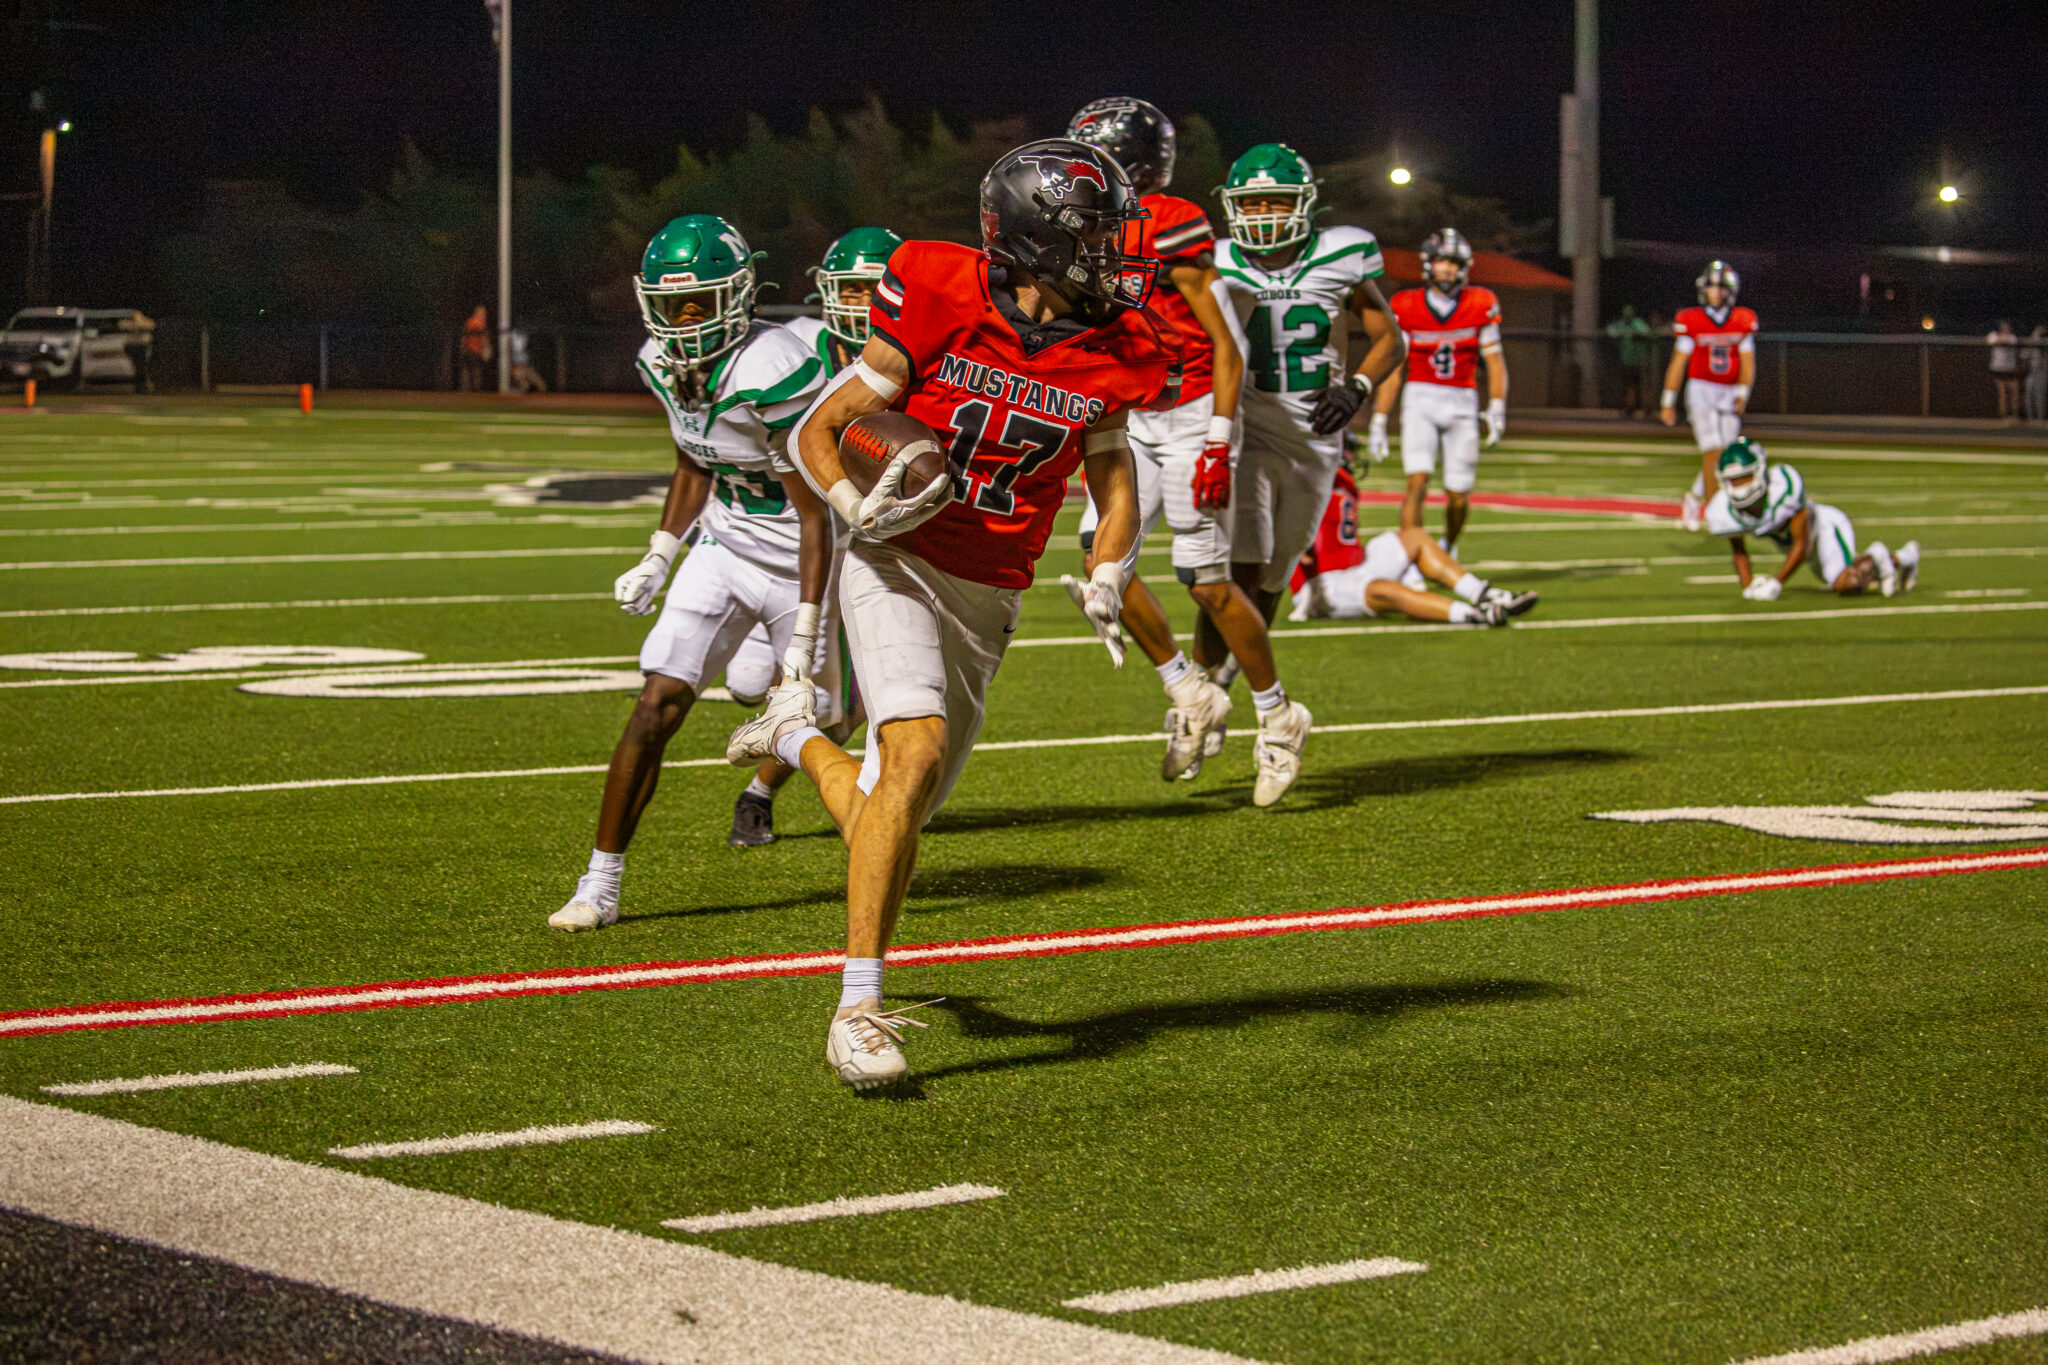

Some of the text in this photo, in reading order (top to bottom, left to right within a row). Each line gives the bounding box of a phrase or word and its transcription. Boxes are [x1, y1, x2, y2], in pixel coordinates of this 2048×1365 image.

[663, 274, 692, 284] Riddell
[1246, 303, 1331, 392] 42
[1428, 341, 1456, 380] 4
[936, 353, 1104, 427] MUSTANGS
[948, 398, 1070, 516] 17
